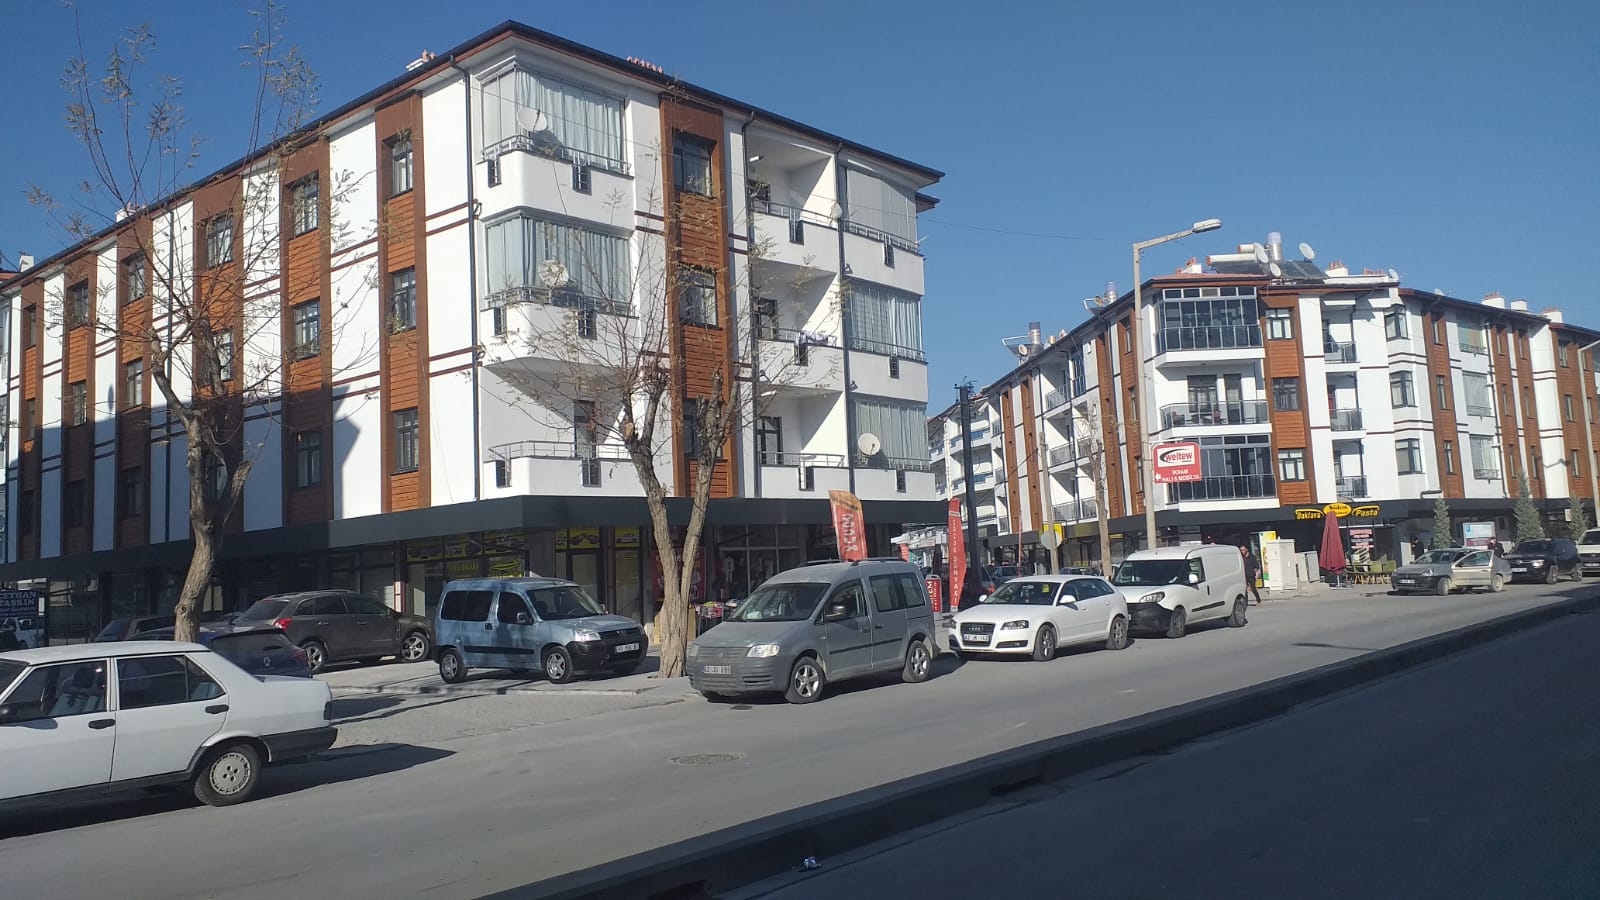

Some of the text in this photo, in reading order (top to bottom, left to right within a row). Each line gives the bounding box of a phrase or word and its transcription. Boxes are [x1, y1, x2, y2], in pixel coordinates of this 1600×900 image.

[1165, 452, 1192, 461] weltew
[1297, 511, 1320, 519] Baklava
[1355, 509, 1378, 517] Pasta
